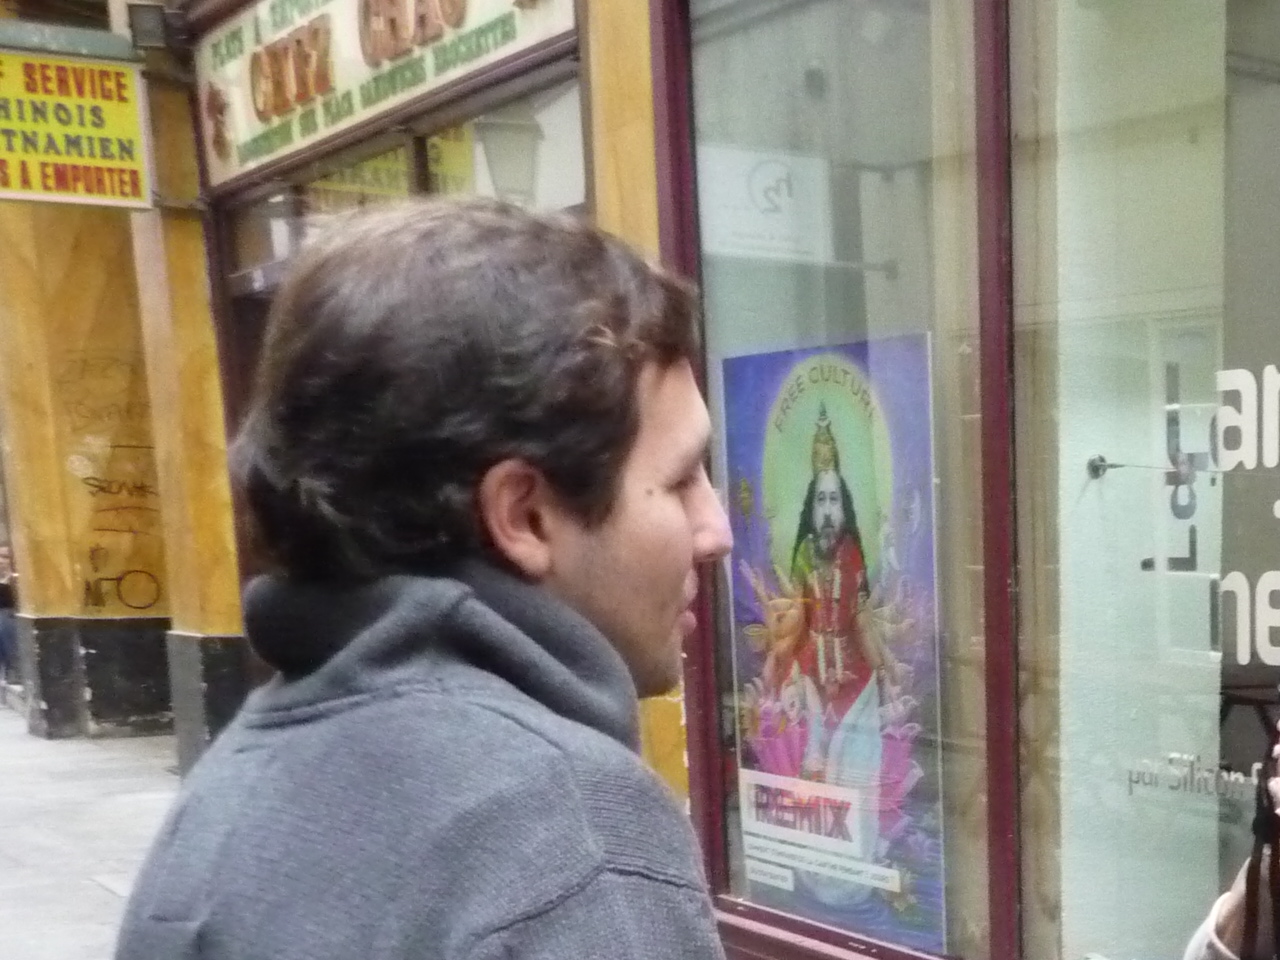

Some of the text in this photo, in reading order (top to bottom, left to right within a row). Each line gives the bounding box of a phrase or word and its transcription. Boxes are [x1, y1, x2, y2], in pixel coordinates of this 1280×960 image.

[23, 62, 128, 102] SERVICE
[1, 128, 134, 161] TNAMIEN
[40, 162, 141, 198] EMPORTER
[774, 373, 805, 433] FREE
[755, 783, 854, 843] REMIX
